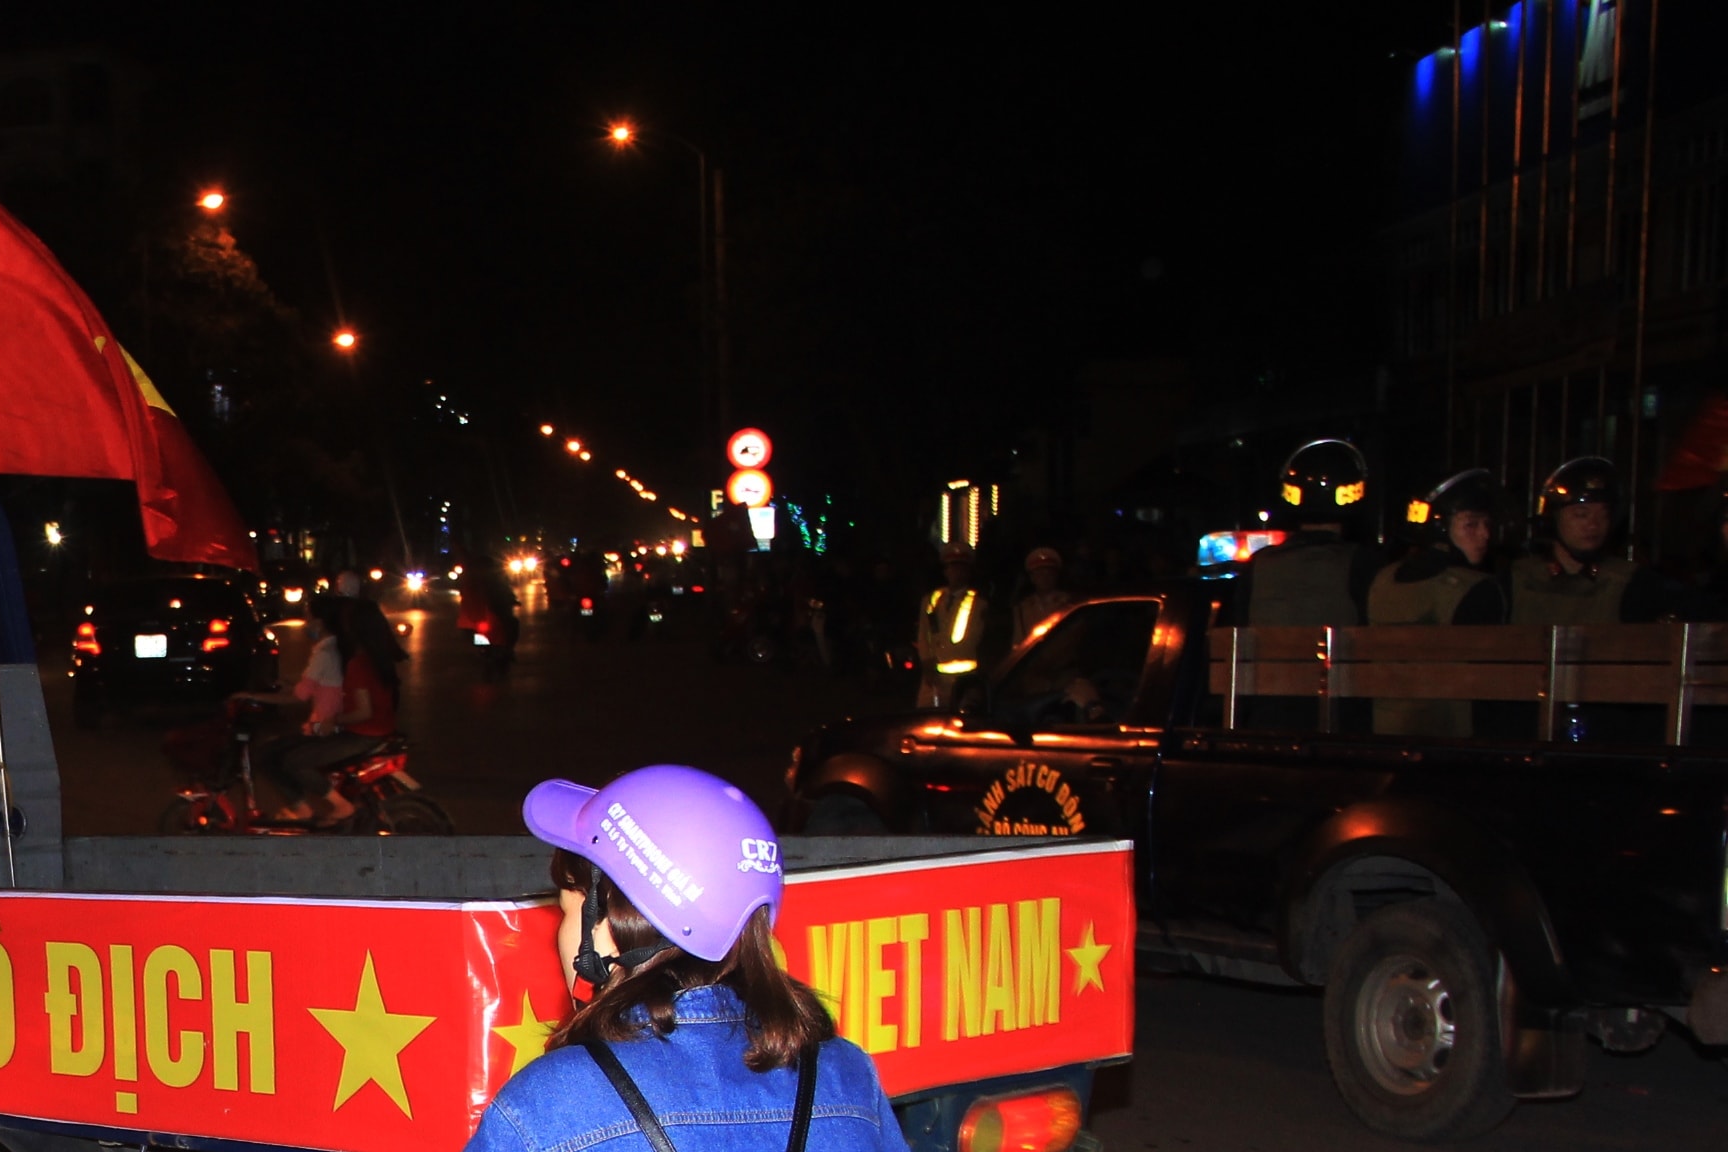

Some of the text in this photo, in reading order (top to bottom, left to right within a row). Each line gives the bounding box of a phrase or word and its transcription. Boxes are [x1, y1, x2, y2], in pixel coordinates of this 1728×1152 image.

[1005, 759, 1038, 793] SÁT
[741, 838, 777, 862] CR7
[943, 897, 1062, 1043] NAM
[43, 940, 278, 1115] ĐỊCH
